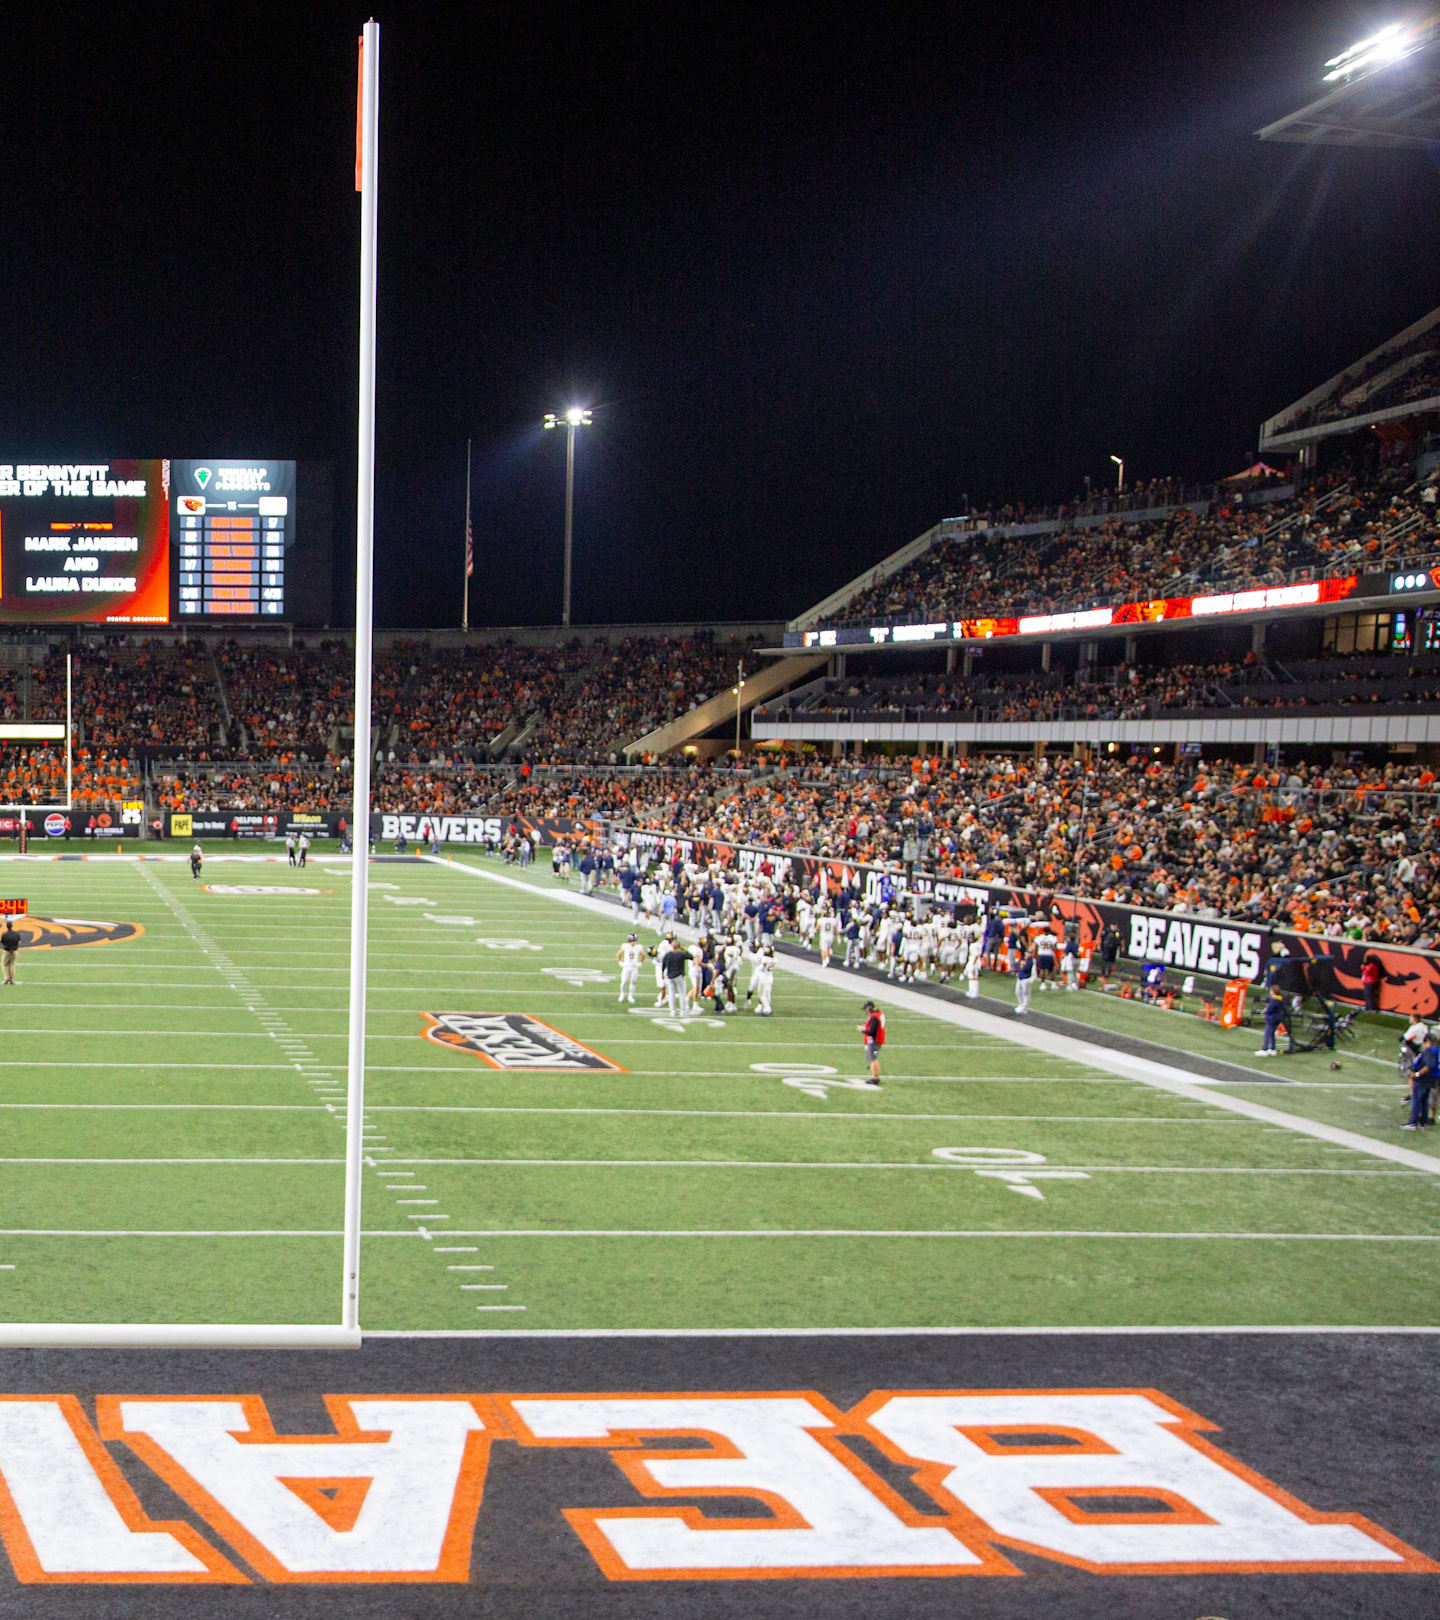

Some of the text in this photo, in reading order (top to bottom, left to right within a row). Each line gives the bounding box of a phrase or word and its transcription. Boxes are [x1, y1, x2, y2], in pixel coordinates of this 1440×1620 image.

[17, 465, 109, 480] BENNYFIT
[23, 480, 48, 496] OF
[54, 480, 89, 496] THE
[92, 480, 146, 496] GAME
[24, 537, 71, 551] MARK
[63, 557, 98, 571] AND
[26, 577, 80, 591] LAURA
[382, 815, 501, 843] BEAVERS
[1129, 913, 1261, 980] BEAVERS
[439, 1015, 591, 1067] RESER
[749, 1062, 884, 1091] 20
[932, 1146, 1092, 1184] 10
